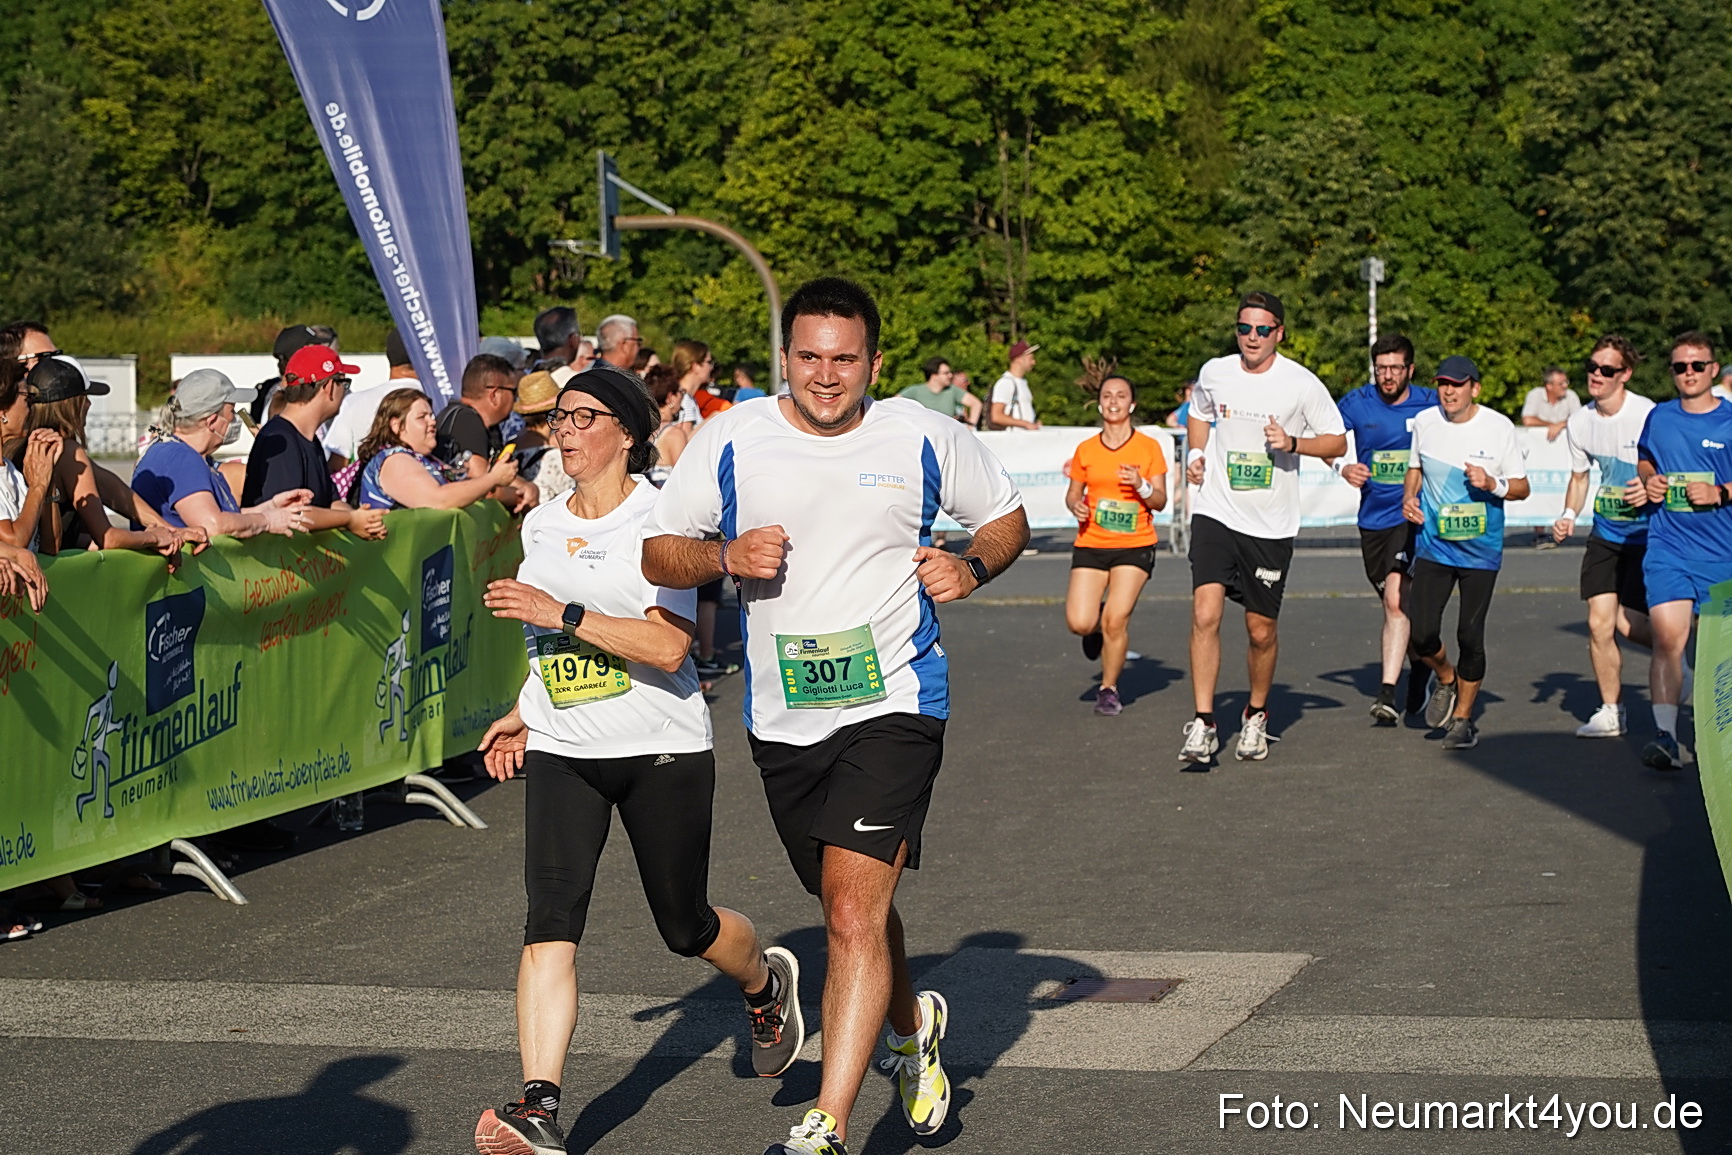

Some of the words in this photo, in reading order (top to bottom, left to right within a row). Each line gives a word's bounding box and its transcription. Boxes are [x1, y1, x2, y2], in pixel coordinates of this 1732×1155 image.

[1232, 409, 1281, 419] SCHWAZ
[1236, 465, 1262, 478] 182
[1380, 462, 1405, 474] 974
[877, 474, 906, 484] PETTER
[1103, 510, 1133, 524] 1392
[1446, 516, 1479, 528] 1183
[158, 625, 193, 655] Fischer
[551, 652, 610, 683] 1979
[802, 656, 852, 685] 307
[864, 654, 880, 690] 2022
[785, 668, 798, 694] RUN
[802, 685, 838, 696] Gigliotti
[839, 682, 864, 692] Luca
[120, 660, 243, 780] firmenlauf
[653, 756, 676, 766] adidas
[121, 760, 178, 808] neumarkt
